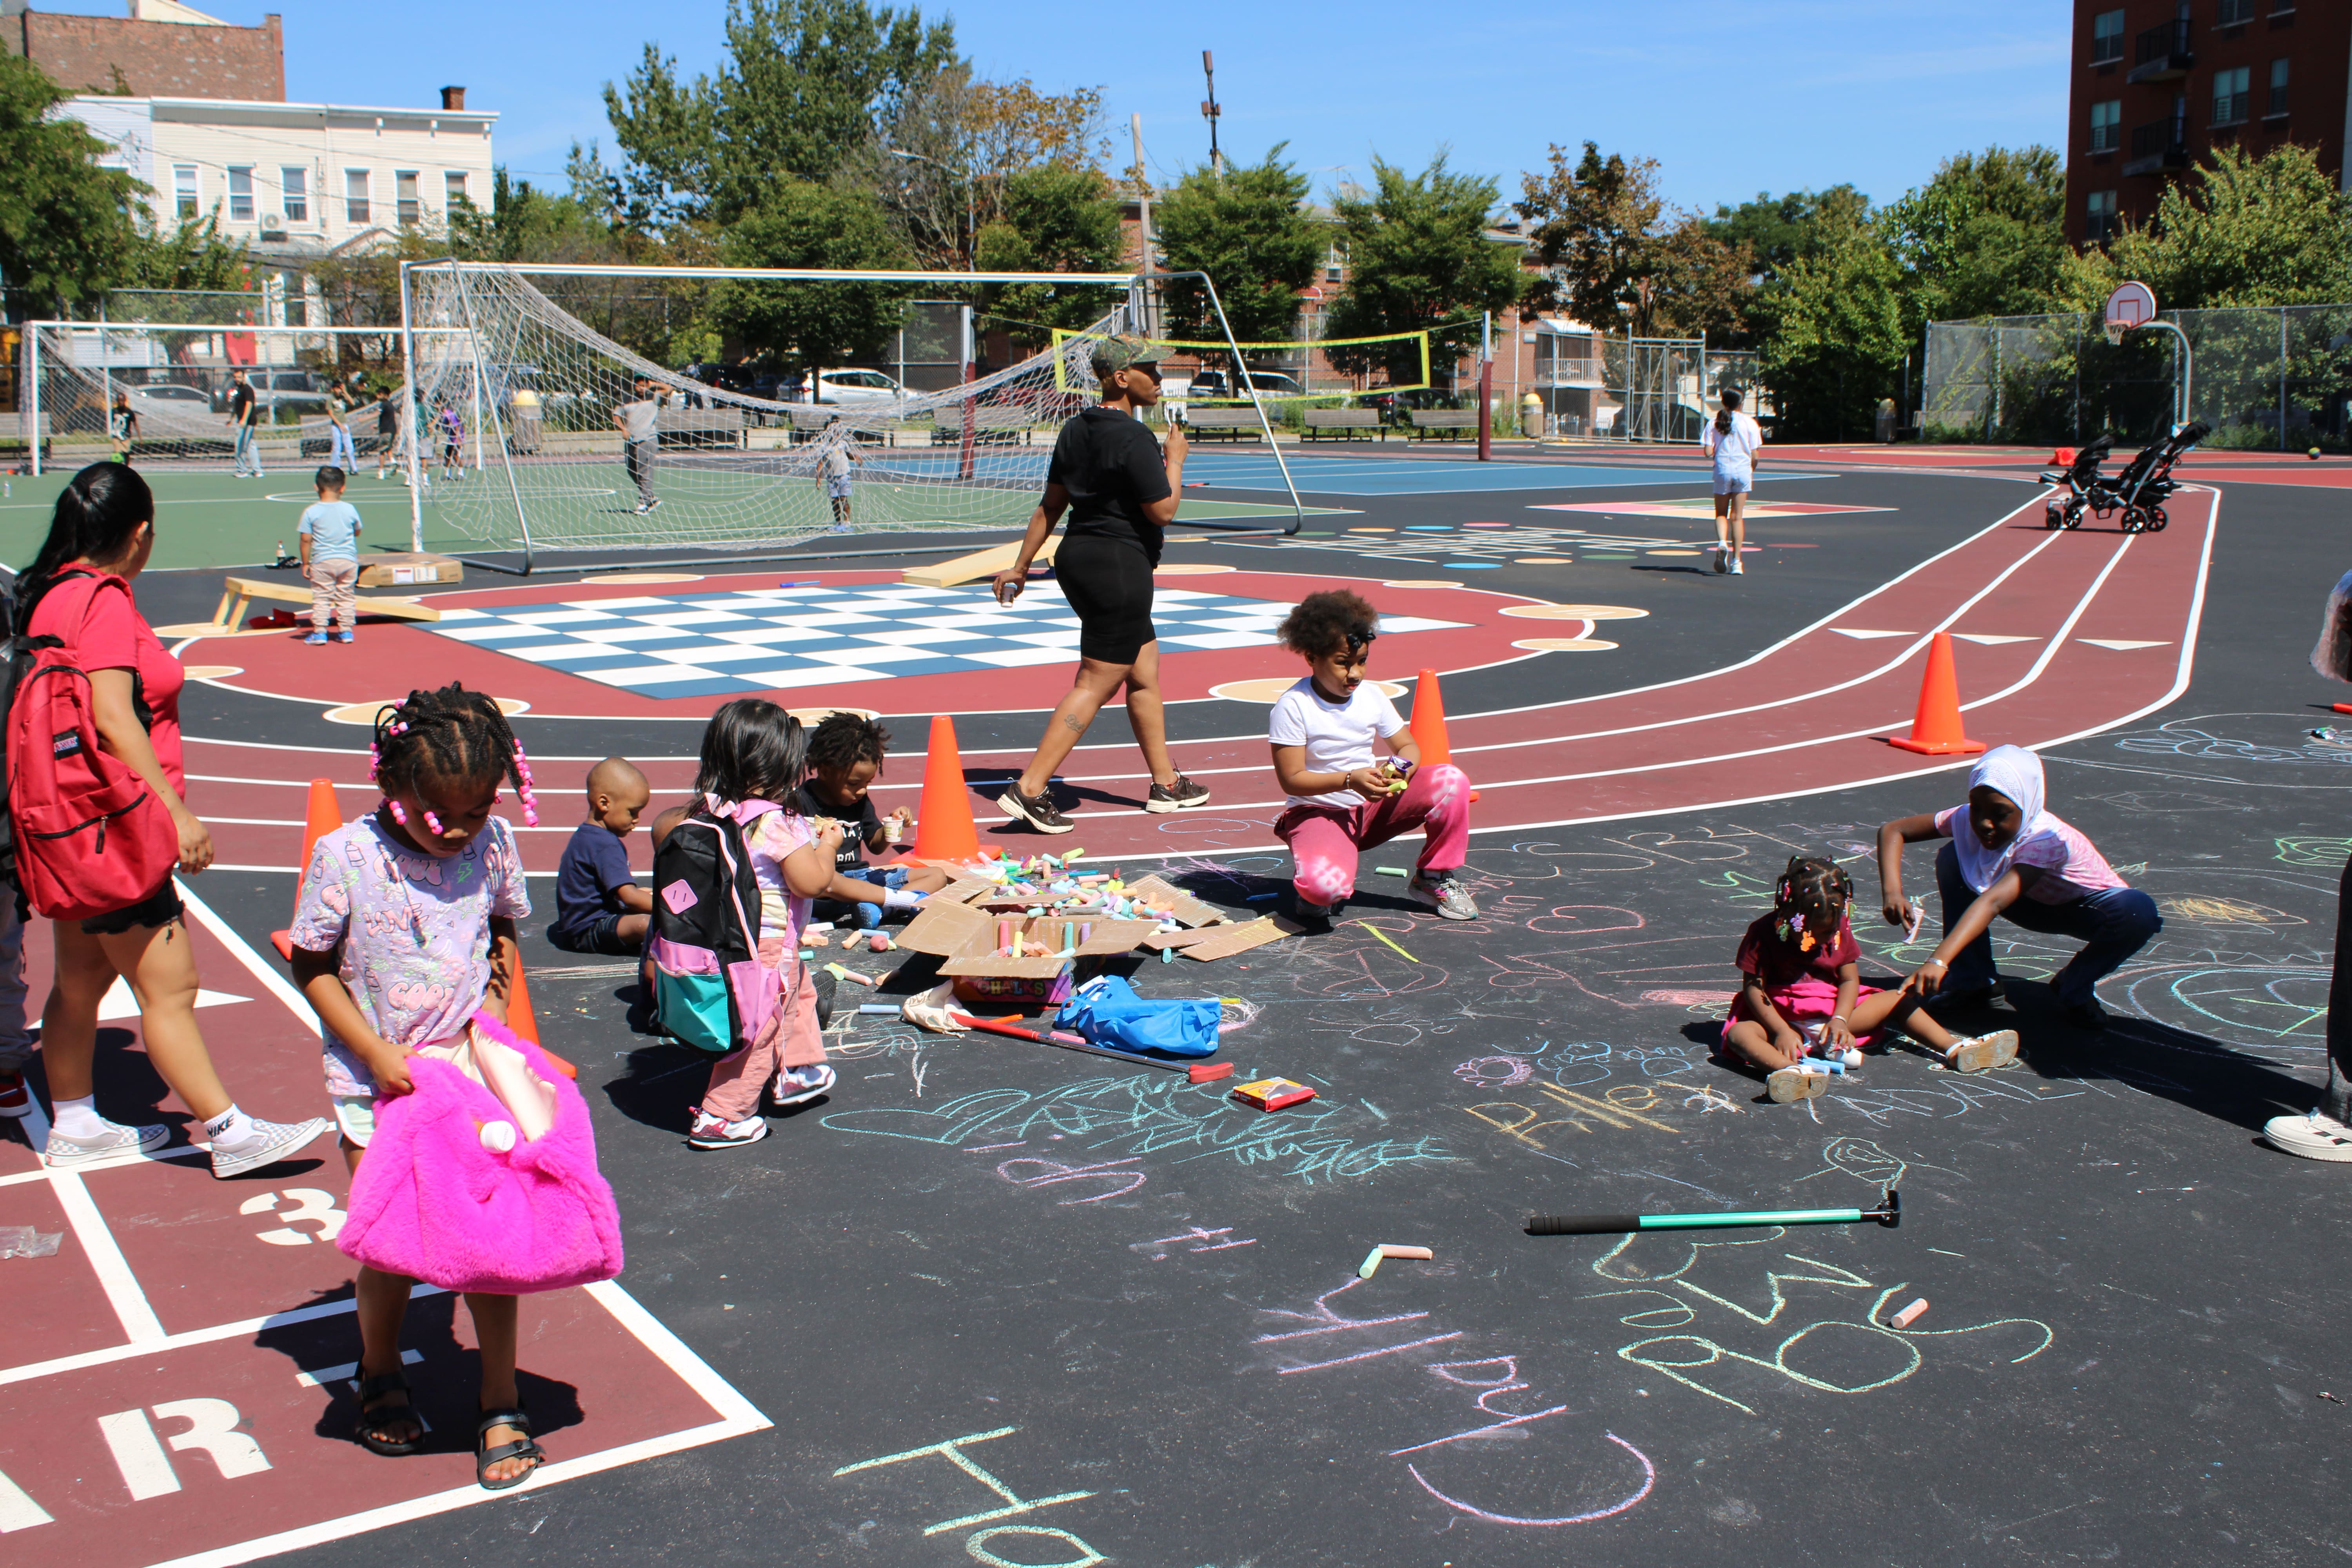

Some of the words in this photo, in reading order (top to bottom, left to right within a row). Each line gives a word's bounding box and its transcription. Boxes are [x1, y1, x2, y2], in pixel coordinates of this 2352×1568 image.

[977, 980, 1046, 997] CHALKS
[207, 1113, 234, 1138] NIKE
[239, 1188, 348, 1246] 3
